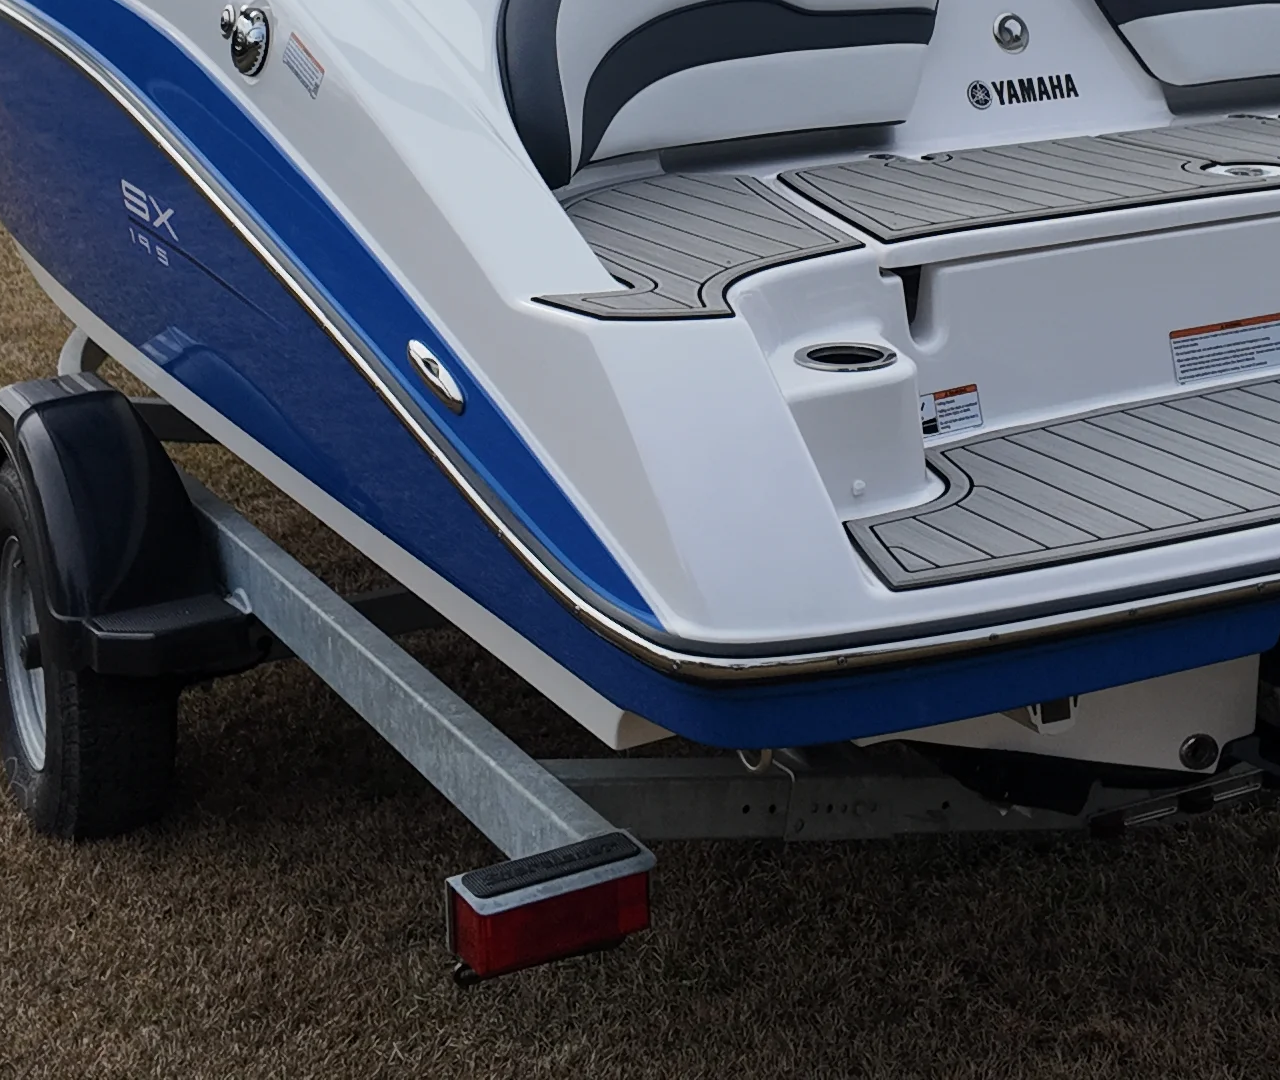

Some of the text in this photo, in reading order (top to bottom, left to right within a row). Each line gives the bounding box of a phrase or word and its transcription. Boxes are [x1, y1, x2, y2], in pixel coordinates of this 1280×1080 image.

[991, 73, 1079, 106] YAMAHA
[121, 179, 179, 242] SX
[129, 227, 169, 267] 195
